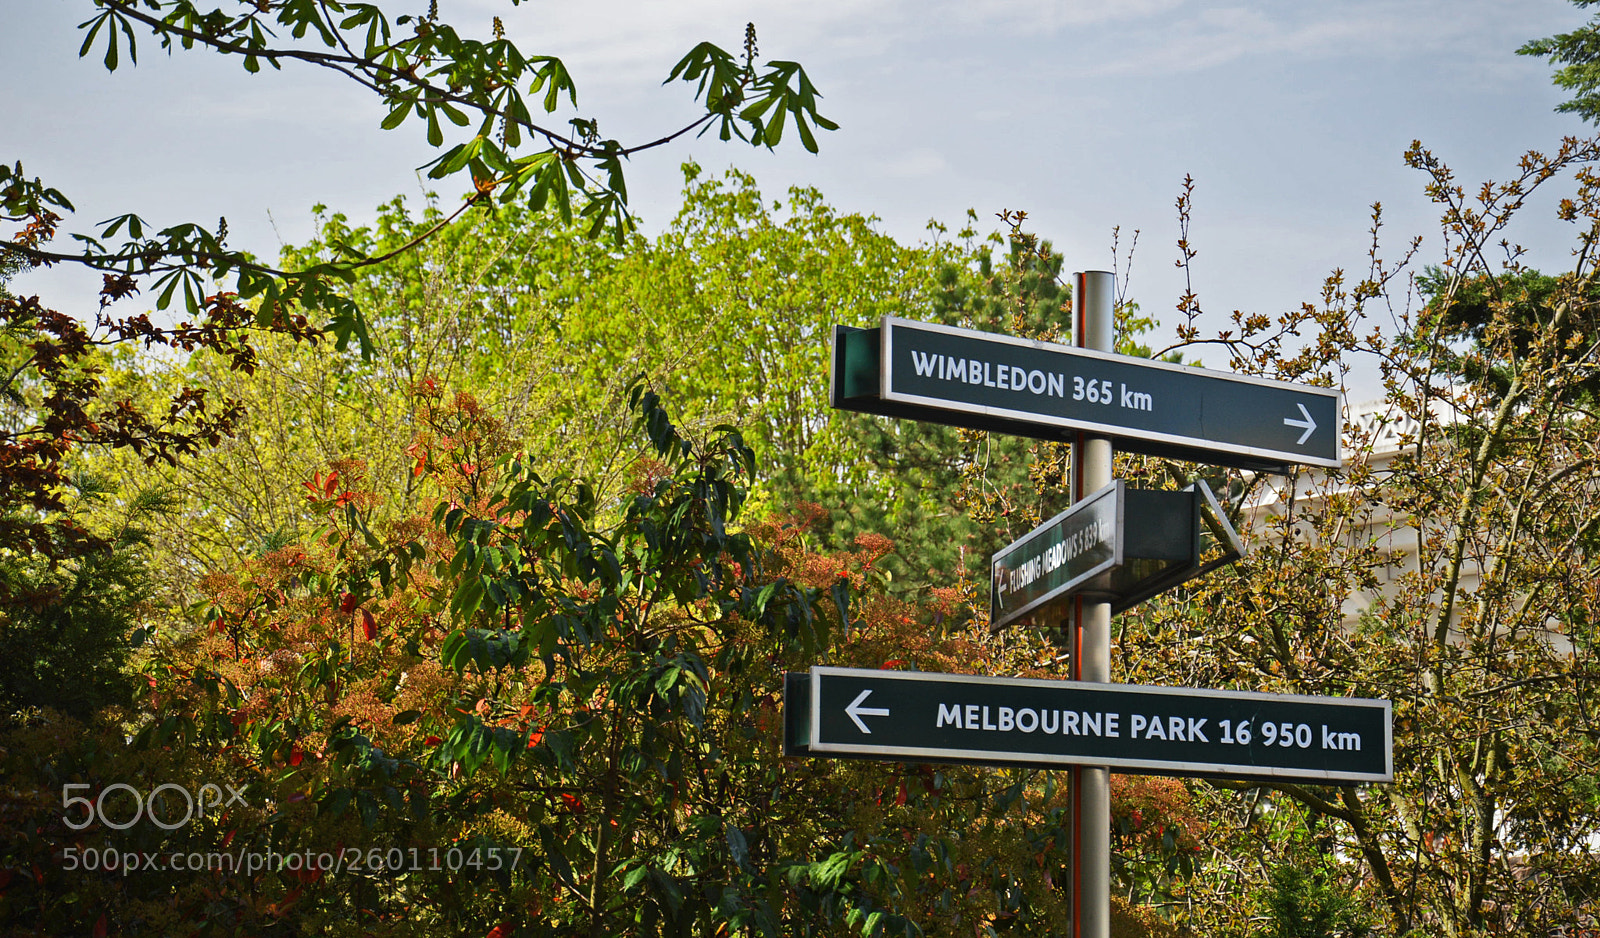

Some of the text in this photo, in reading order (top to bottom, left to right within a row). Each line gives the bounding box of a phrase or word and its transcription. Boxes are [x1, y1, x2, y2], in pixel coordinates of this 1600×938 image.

[911, 350, 1153, 412] WIMBLEDON 365 km
[1009, 555, 1041, 594] FLUSHING
[1041, 533, 1078, 576] MEADOWS
[1078, 529, 1084, 555] 5
[1084, 521, 1098, 551] 839
[936, 703, 1361, 751] MELBOURNE PARK 16 950 km
